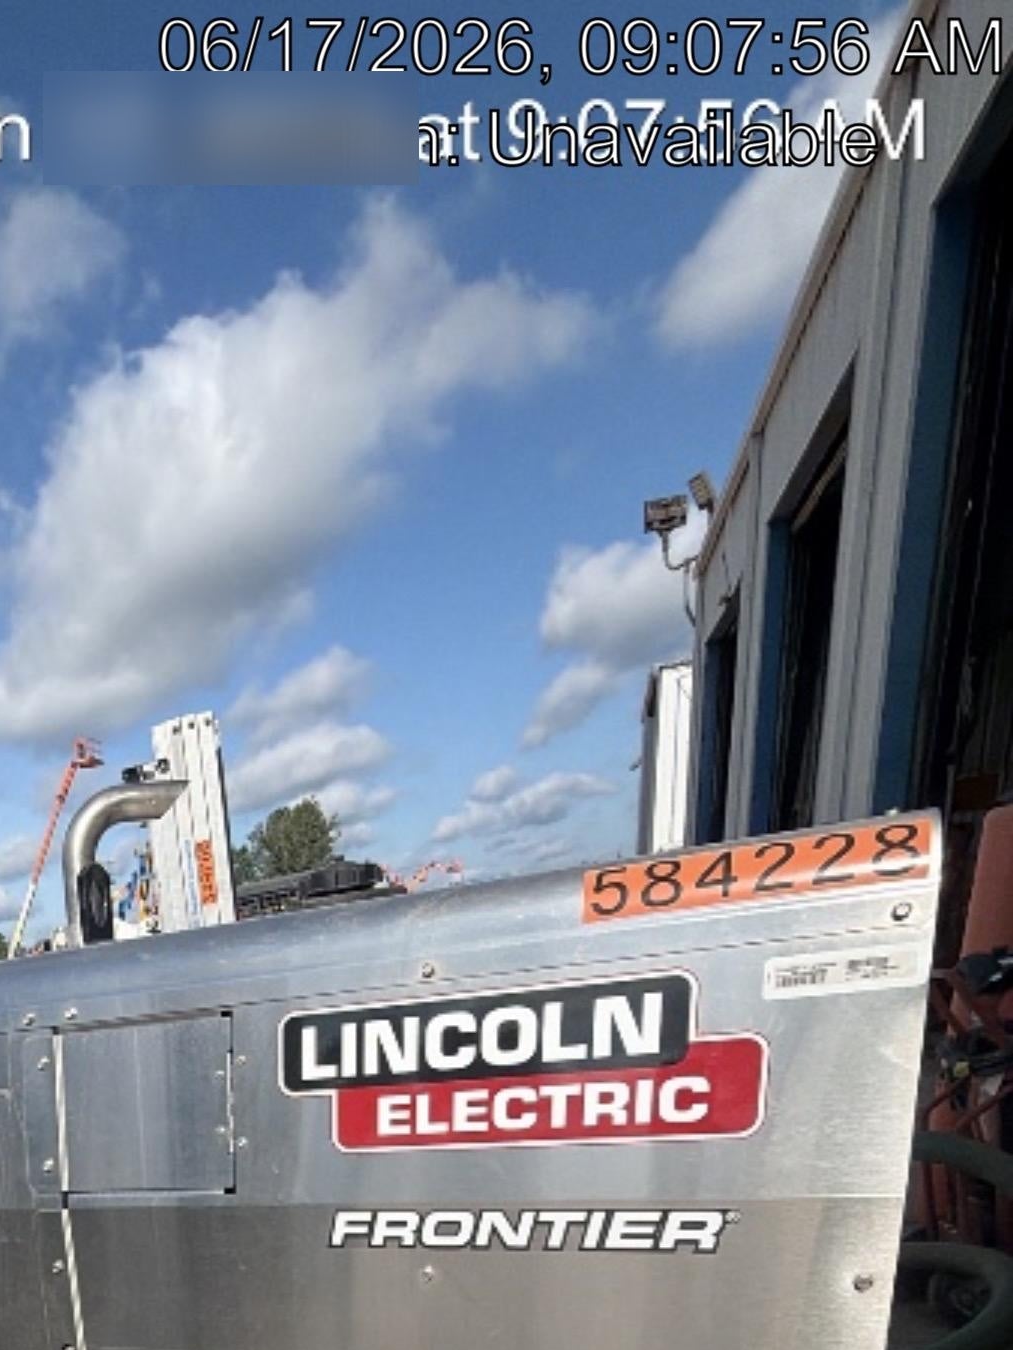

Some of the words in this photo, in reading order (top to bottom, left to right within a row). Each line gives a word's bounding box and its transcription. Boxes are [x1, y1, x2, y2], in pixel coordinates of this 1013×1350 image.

[591, 824, 918, 915] 584228
[301, 992, 664, 1081] LINCOLN
[377, 1076, 710, 1137] ELECTRIC
